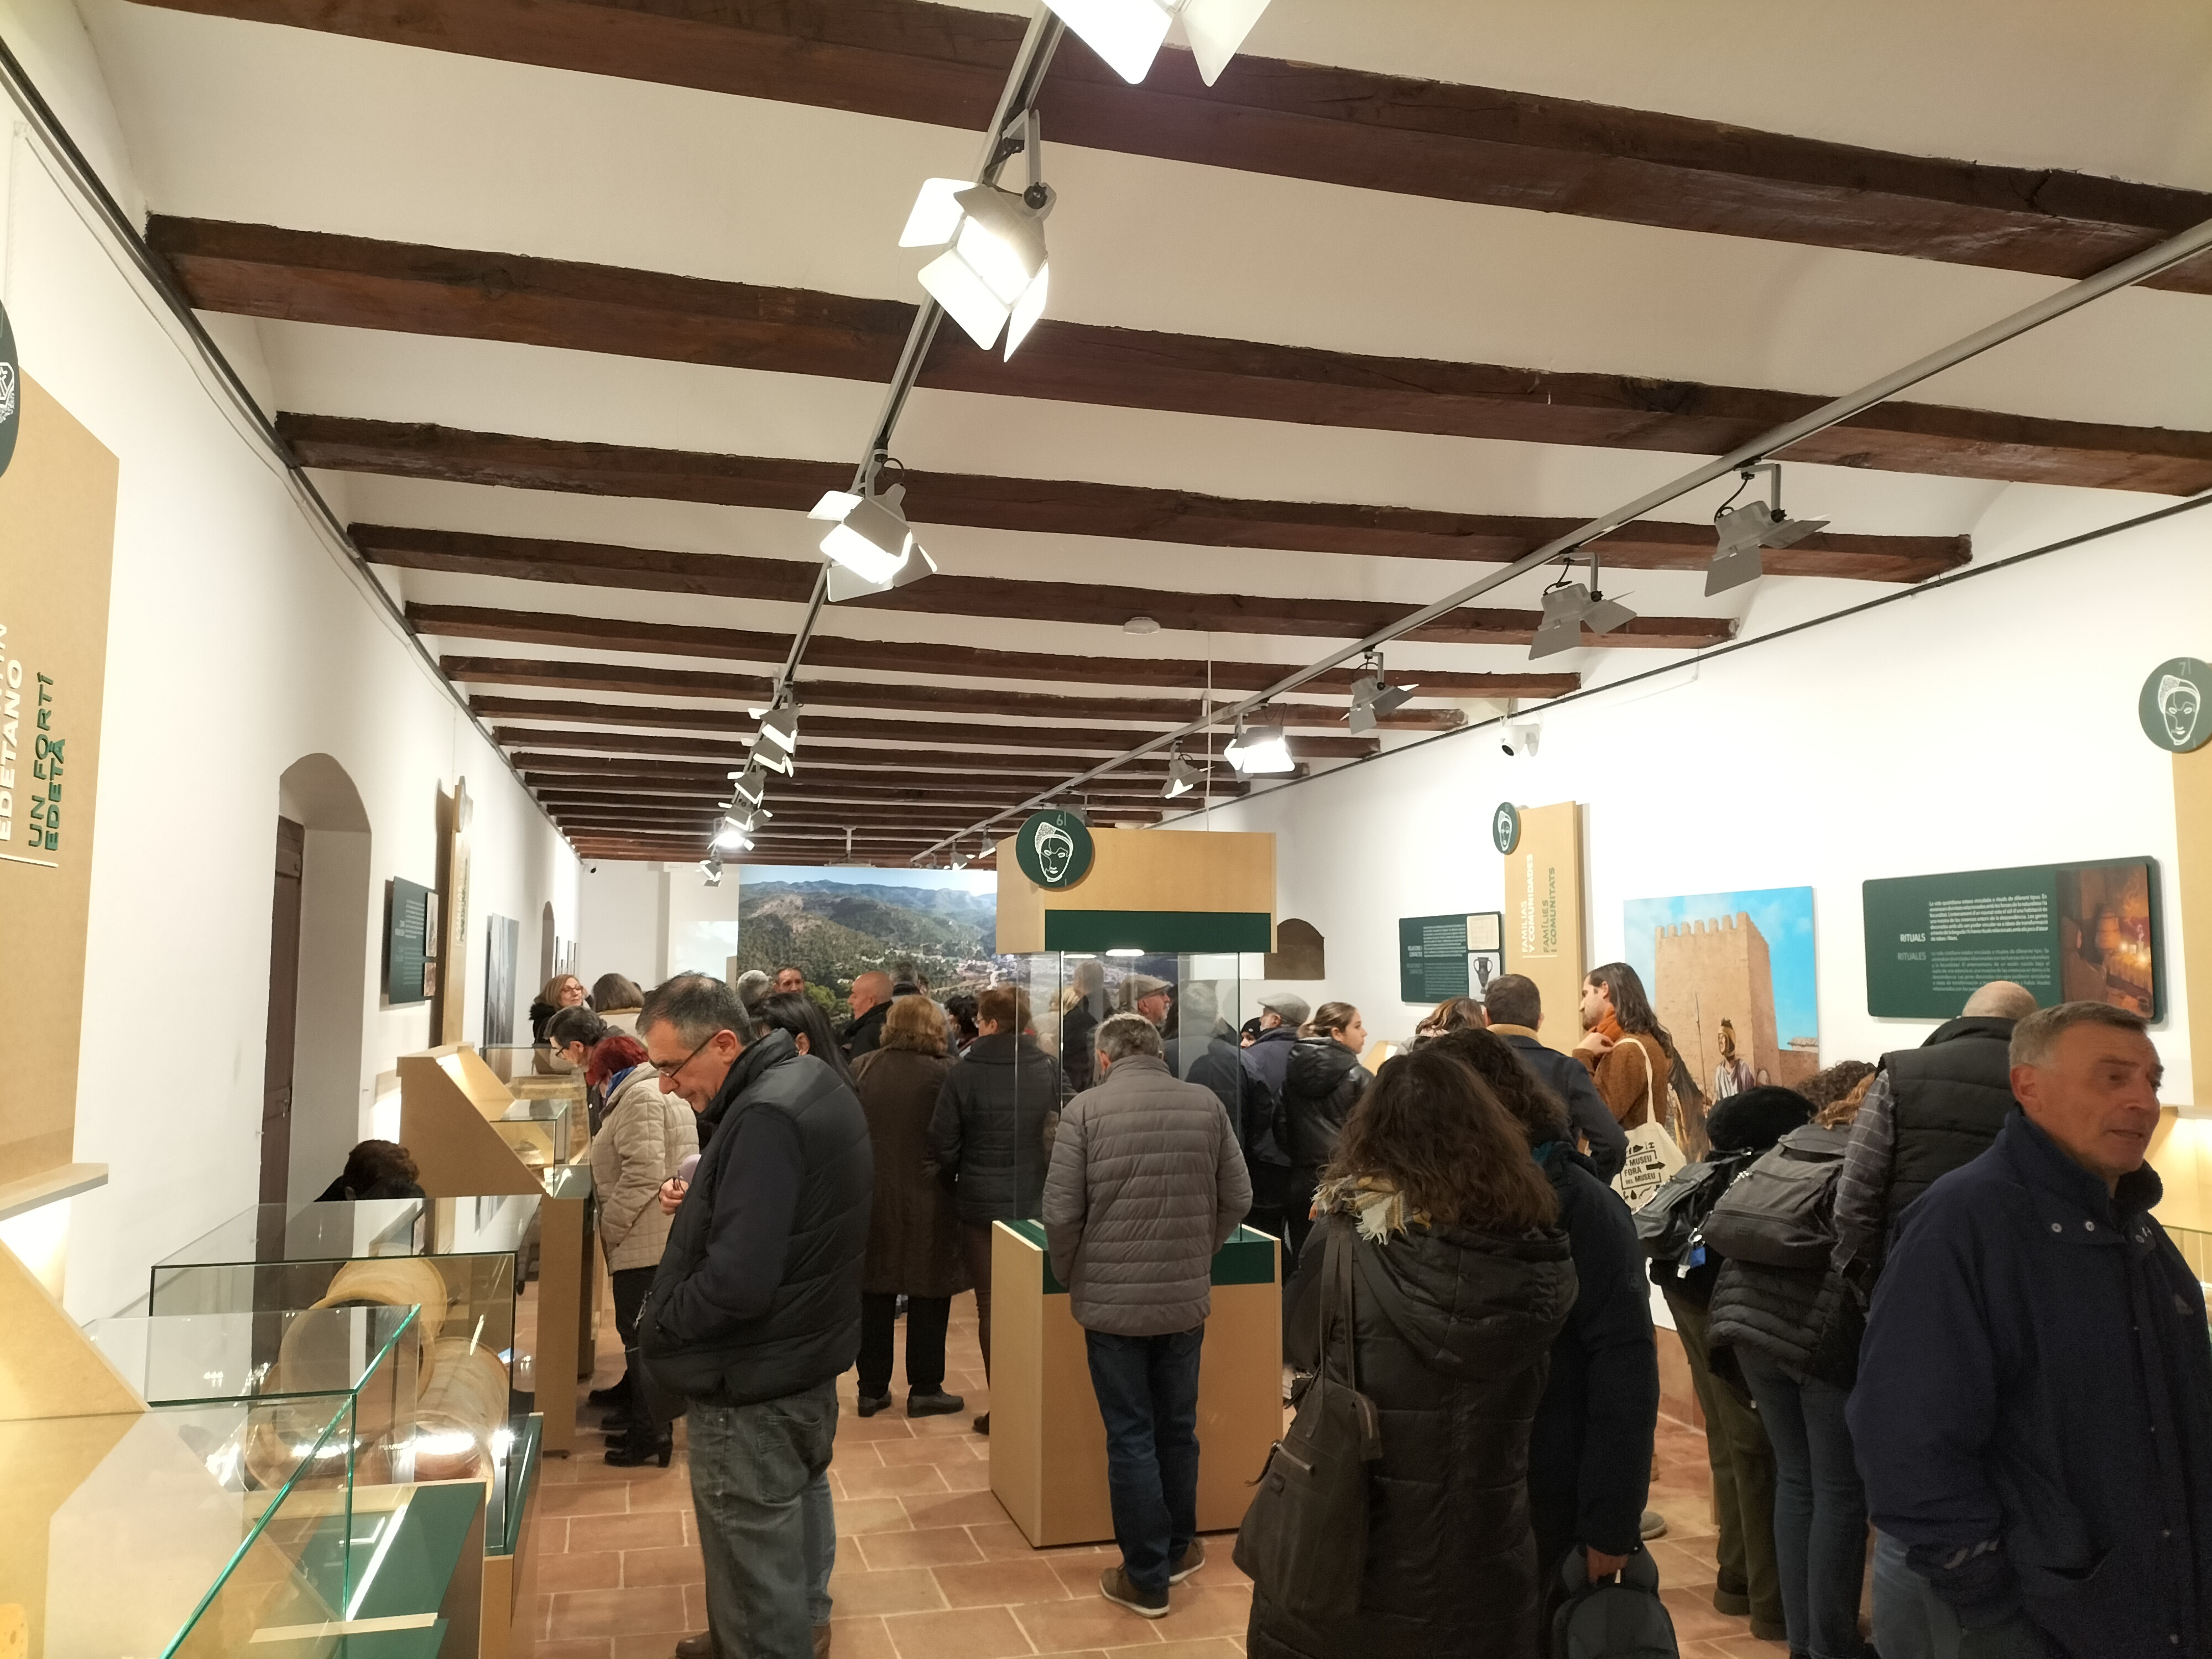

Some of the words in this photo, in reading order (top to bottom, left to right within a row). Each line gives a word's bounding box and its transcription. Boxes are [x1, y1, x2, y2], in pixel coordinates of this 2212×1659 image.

[34, 672, 54, 780] FORTÍ
[0, 660, 22, 841] EDETANO
[29, 795, 45, 847] UN
[1056, 814, 1063, 826] 6
[1526, 853, 1535, 942] COMUNIDADES
[1900, 933, 1926, 942] RITUALS
[1528, 945, 1535, 953] Y
[1898, 952, 1926, 961] RITUALES
[1629, 1155, 1652, 1166] MUSEU
[1624, 1166, 1642, 1177] FORA
[1635, 1172, 1655, 1182] MUSEU
